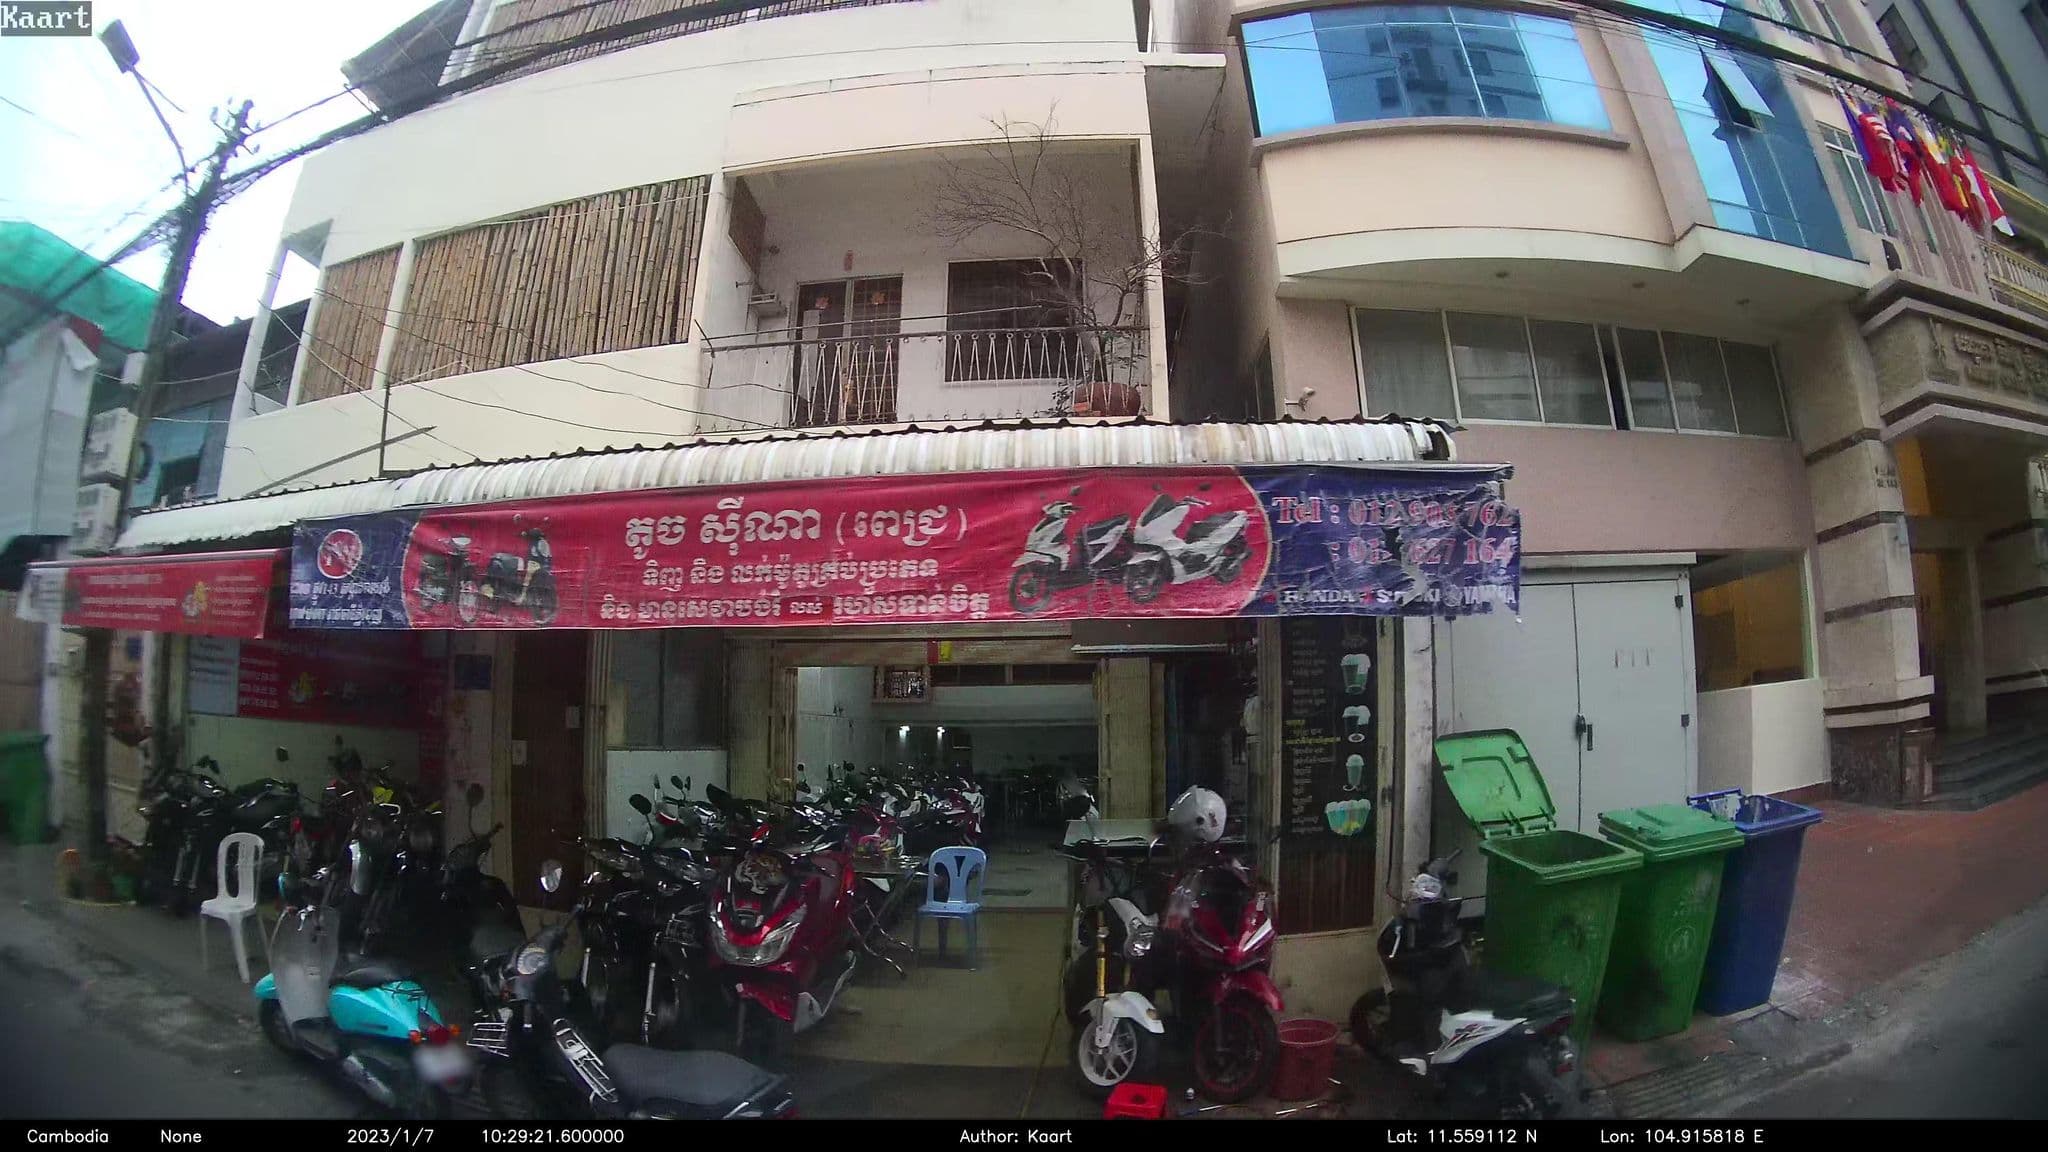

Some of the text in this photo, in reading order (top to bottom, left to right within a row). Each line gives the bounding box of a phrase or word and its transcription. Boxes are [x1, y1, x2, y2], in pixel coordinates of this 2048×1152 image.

[624, 514, 688, 560] តូច
[642, 559, 683, 592] ទិញ
[690, 557, 725, 586] និង
[600, 594, 632, 620] និង
